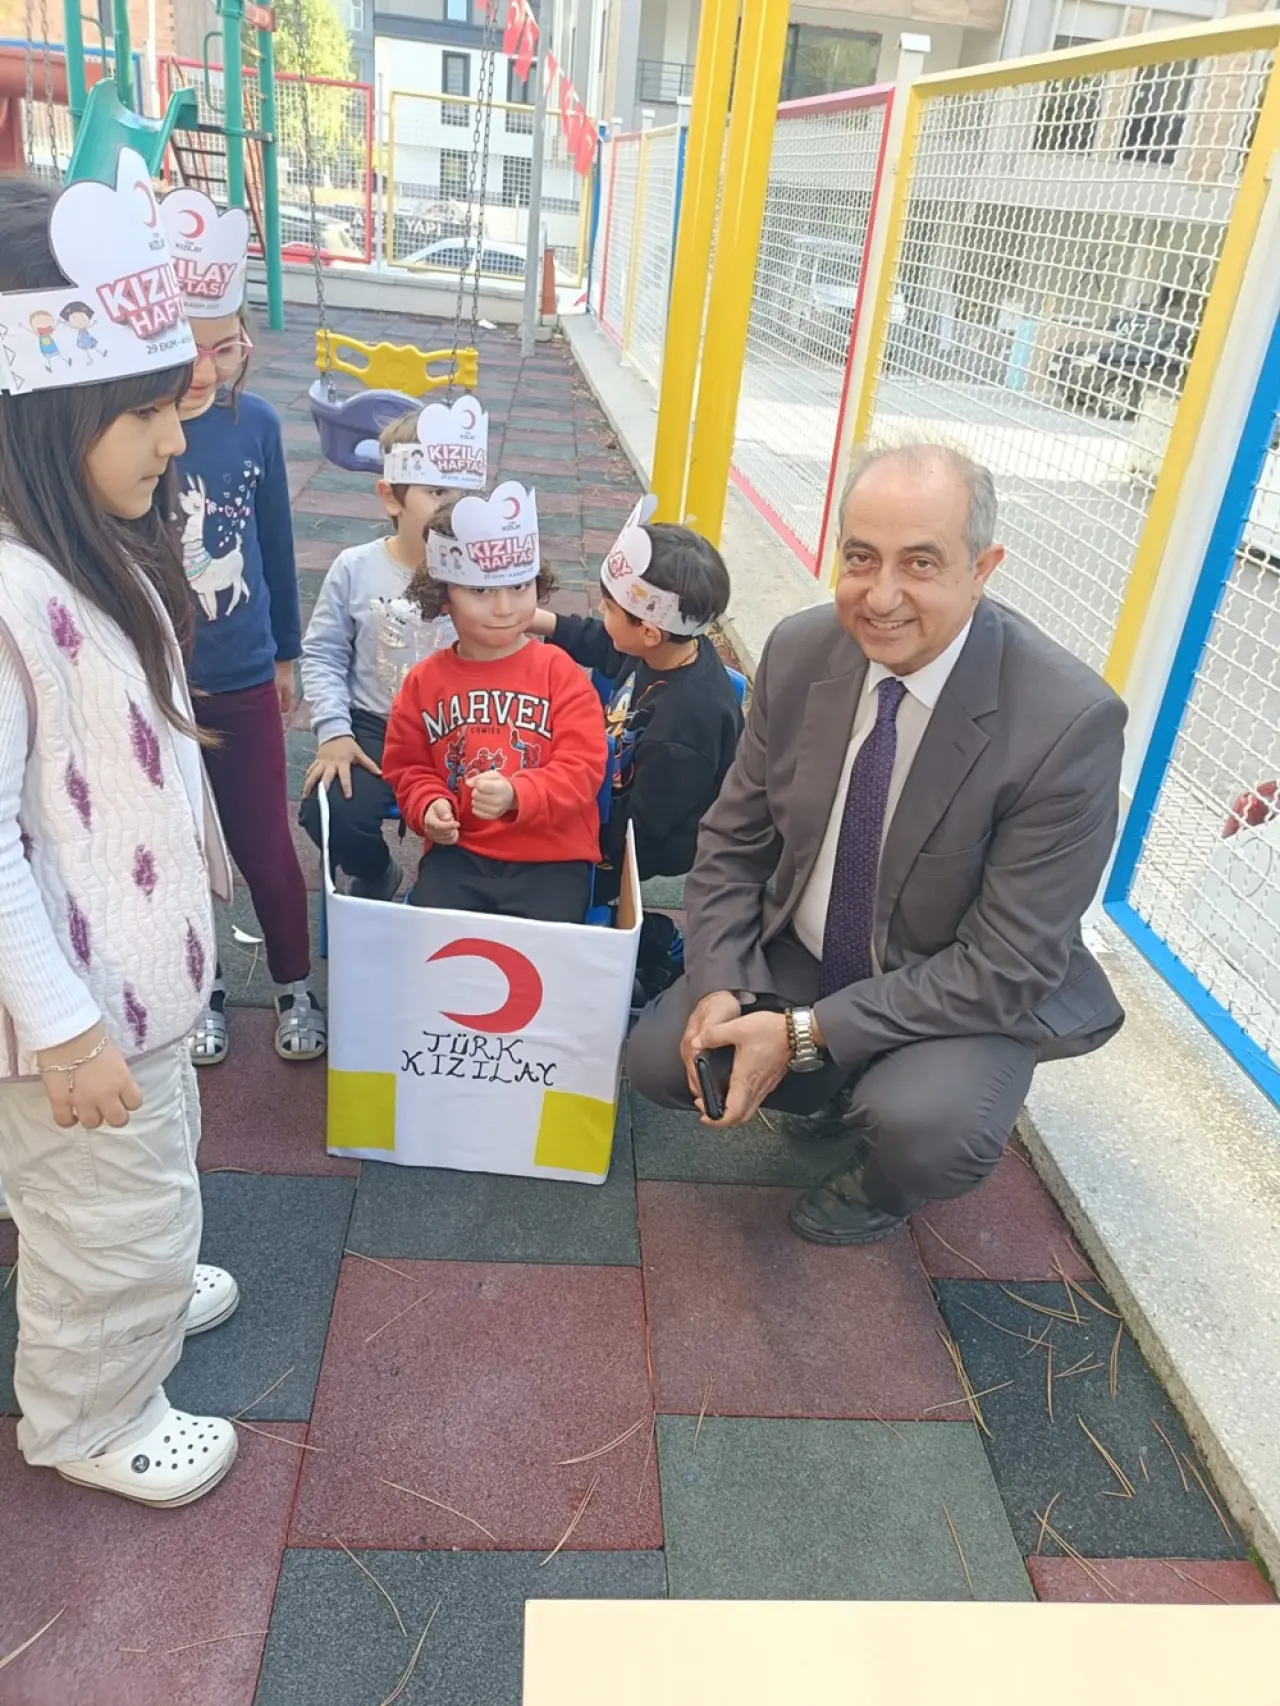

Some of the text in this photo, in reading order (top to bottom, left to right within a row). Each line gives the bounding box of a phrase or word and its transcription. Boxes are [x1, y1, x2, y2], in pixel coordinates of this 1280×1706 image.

[421, 688, 553, 746] MARVEL
[422, 1030, 524, 1064] TÜRK
[401, 1049, 558, 1086] KIZILAY
